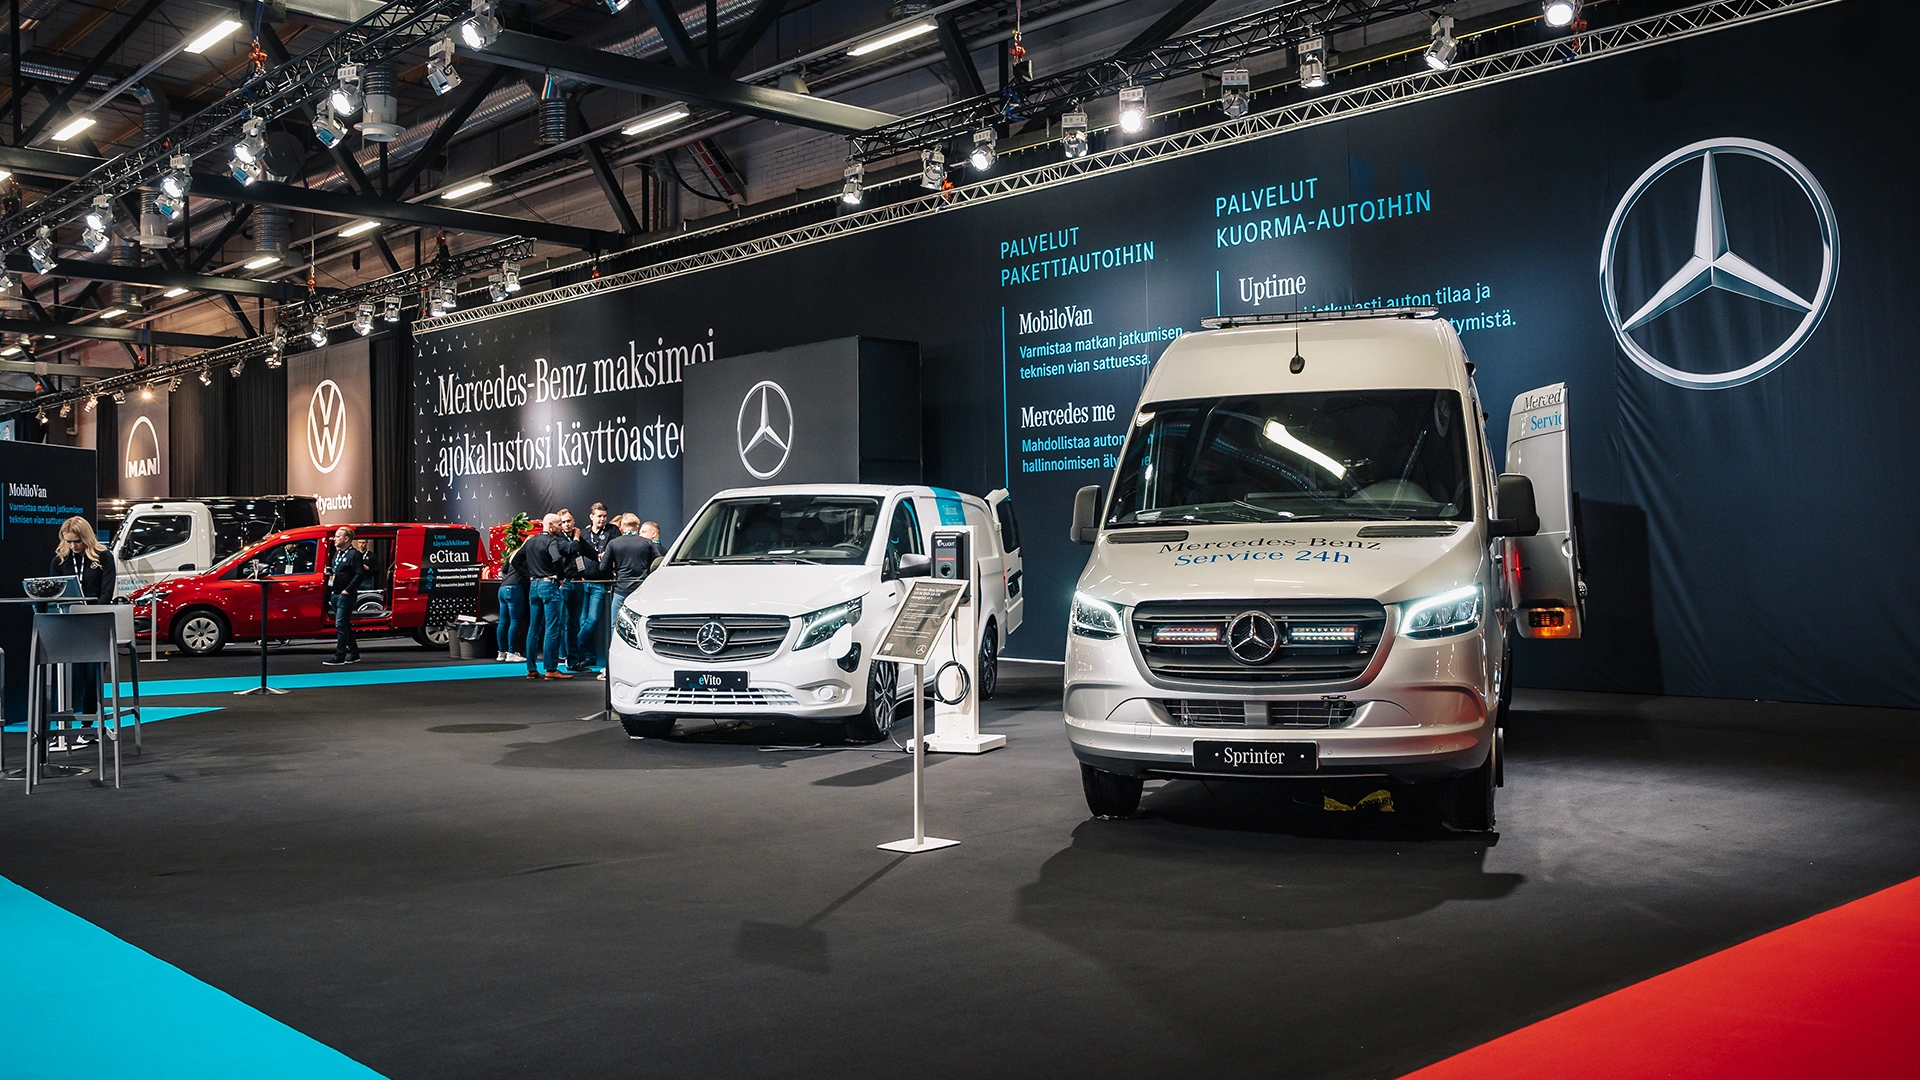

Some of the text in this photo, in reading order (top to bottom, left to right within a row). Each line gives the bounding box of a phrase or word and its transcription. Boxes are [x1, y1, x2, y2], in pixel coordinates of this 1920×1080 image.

[1216, 177, 1318, 217] PALVELUT
[1216, 189, 1431, 248] KUORMA-AUTOIHIN
[1000, 226, 1080, 259] PALVELUT
[1001, 240, 1155, 287] PAKETTIAUTOIHIN
[1239, 273, 1307, 306] Uptime
[1435, 286, 1471, 304] tilaa
[1474, 282, 1491, 304] ja
[1019, 305, 1094, 335] MobiloVan
[1019, 325, 1183, 359] Varmistaa matkan jatkumisen
[1020, 353, 1151, 379] teknisen vian sattuessa.
[438, 356, 588, 417] Mercedes-Benz
[1523, 388, 1562, 411] Merced
[1021, 402, 1116, 428] Mercedes me
[1022, 435, 1090, 453] Mahdollistaa
[438, 424, 552, 488] ajokalustosi
[1022, 456, 1100, 473] hallinnoimisen
[128, 457, 157, 478] MAN
[8, 482, 47, 498] MobiloVan
[9, 502, 37, 512] Varmistaa
[37, 504, 57, 512] matkan
[9, 515, 33, 524] teknisen
[429, 549, 470, 563] eCitan
[1158, 537, 1382, 555] Mercedes-Benz
[1174, 550, 1351, 567] Service 24h
[698, 673, 722, 686] eVito
[1224, 747, 1286, 767] Sprinter
